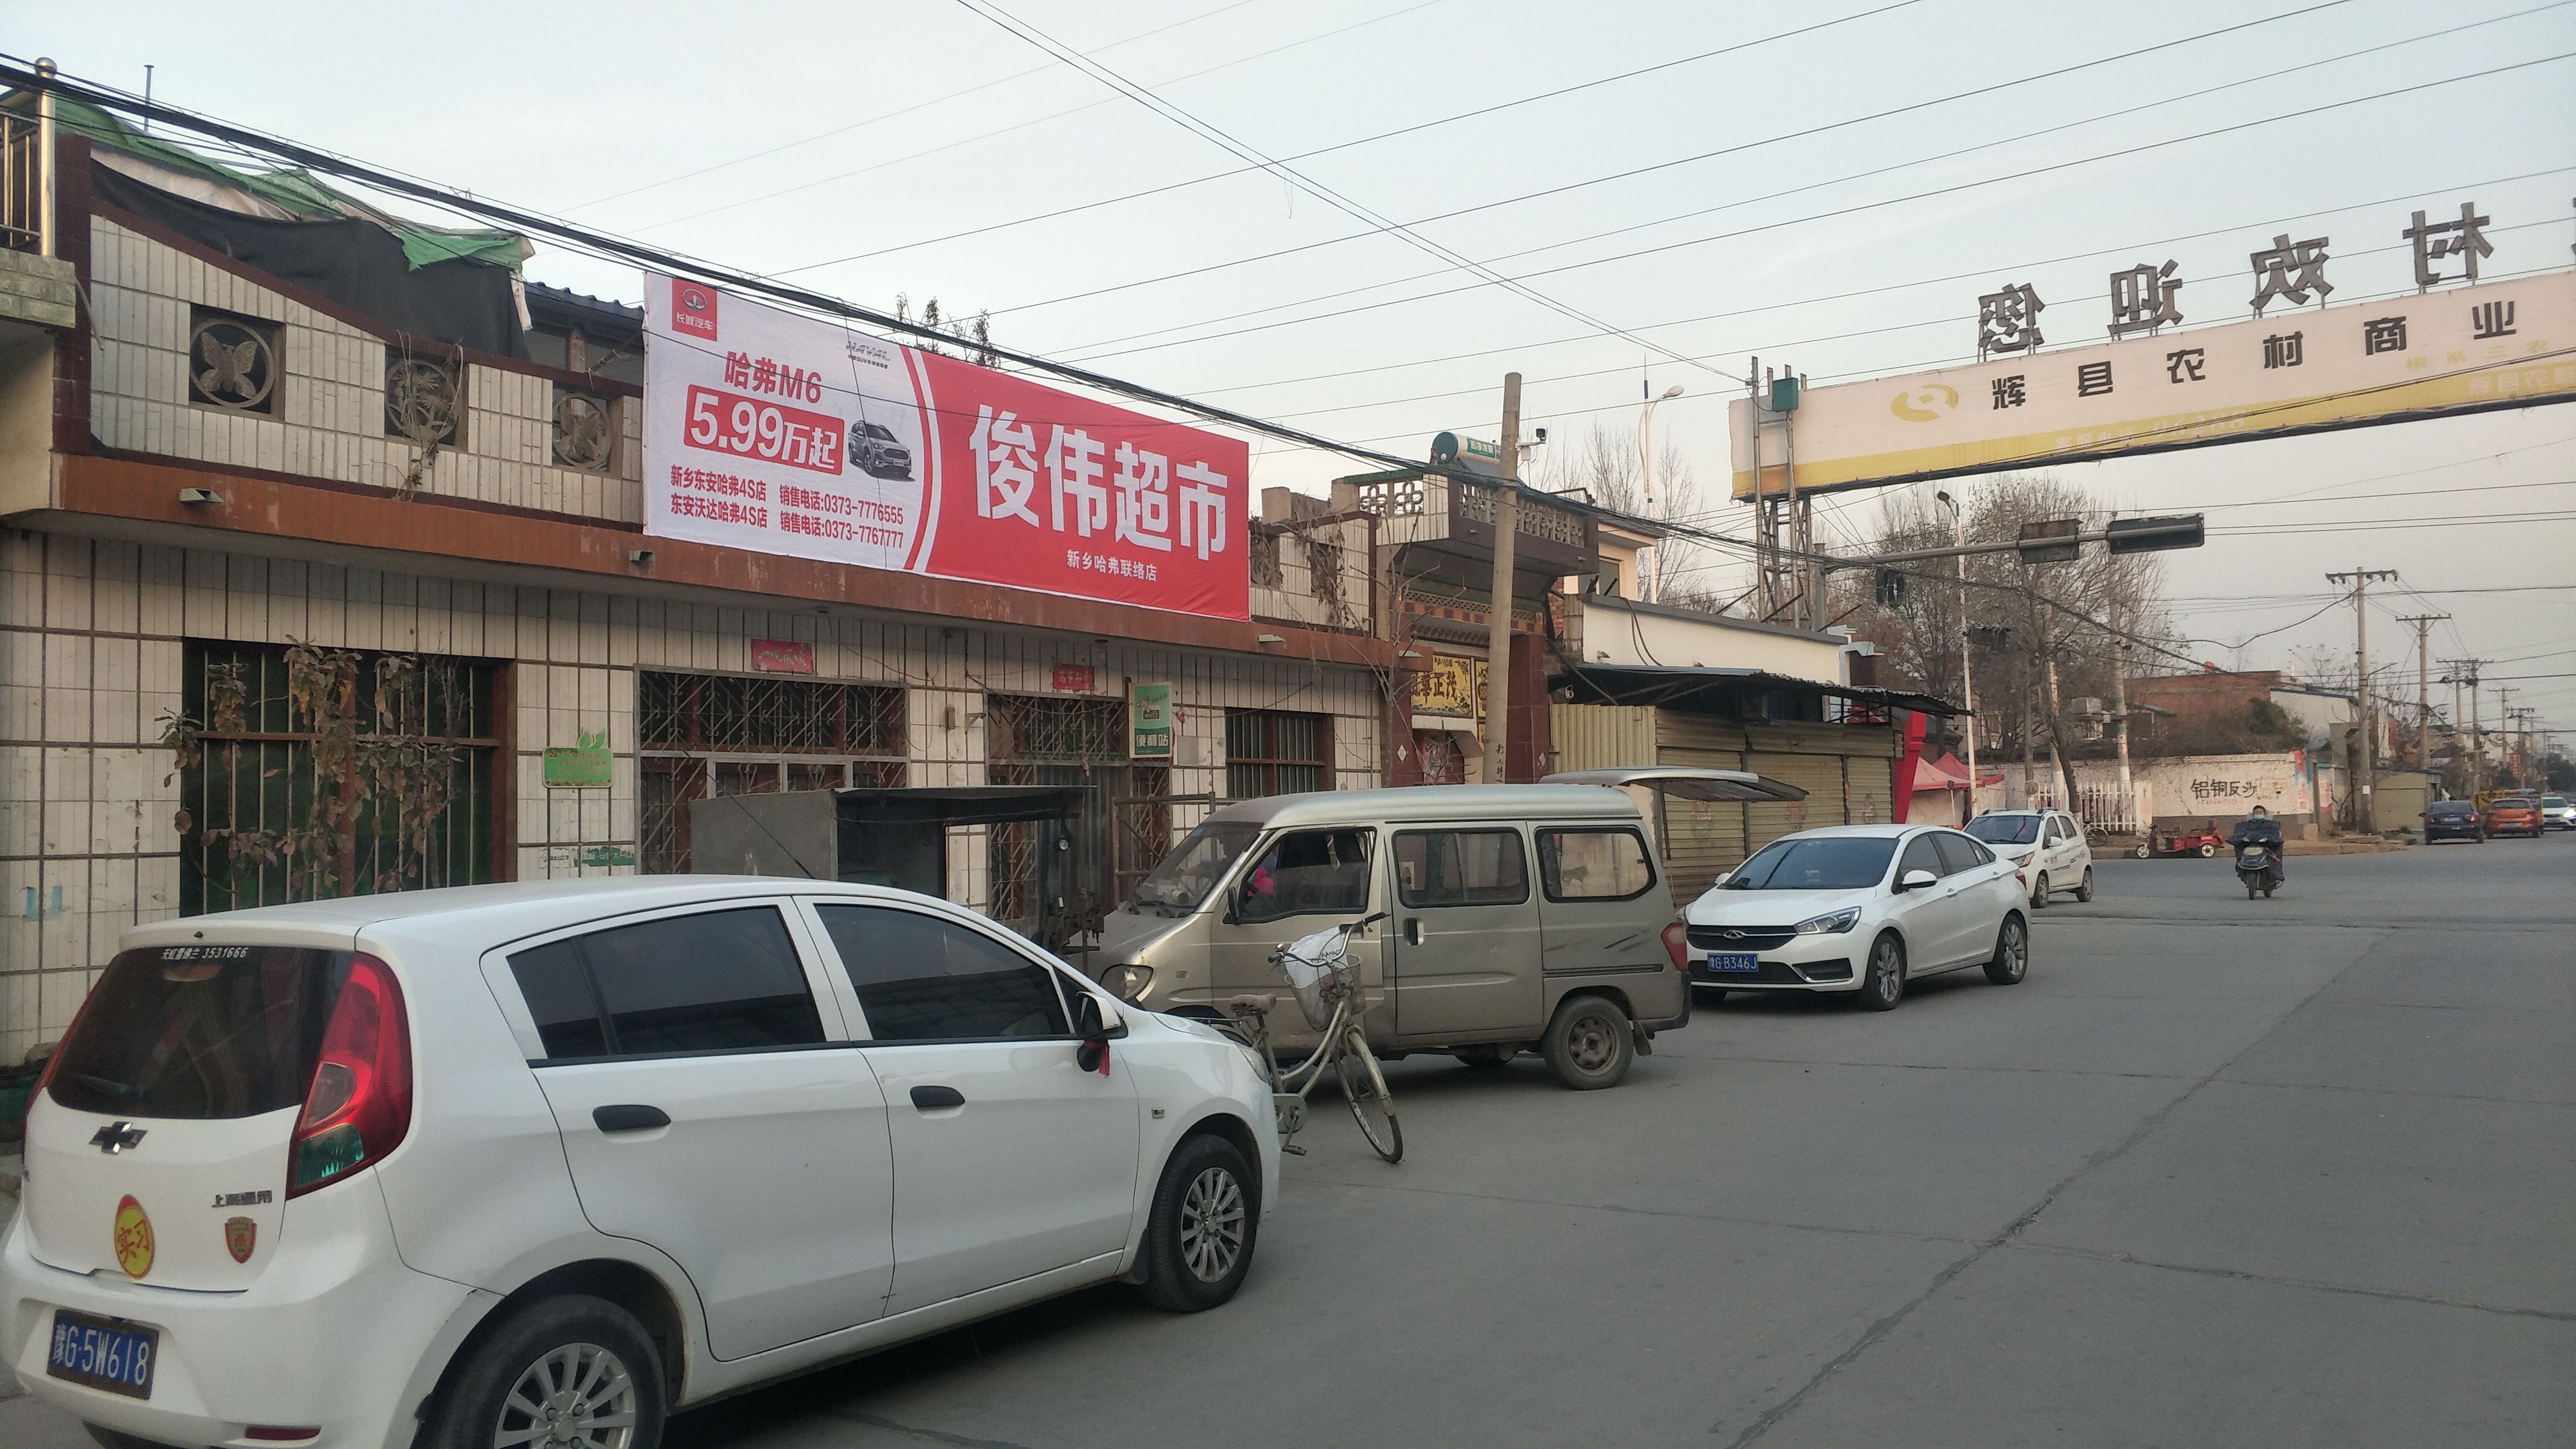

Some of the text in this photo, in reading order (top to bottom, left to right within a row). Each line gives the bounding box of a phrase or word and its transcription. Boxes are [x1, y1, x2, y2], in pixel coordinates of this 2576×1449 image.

[676, 312, 713, 330] 长城汽车
[845, 340, 890, 361] HAVAL
[1991, 301, 2517, 410] 辉县农村商业
[724, 351, 822, 404] 哈弗M6
[690, 392, 837, 470] 5.99万起
[670, 464, 903, 525] 新乡东安哈弗4S店 销售电话:0373-7776555
[969, 404, 1228, 561] 俊伟超市
[670, 493, 768, 529] 东安沃达哈弗4S店
[1066, 549, 1157, 582] 新乡哈弗联络店
[1136, 733, 1168, 747] 便利站
[201, 947, 249, 959] 3531666
[118, 1219, 150, 1265] 实习
